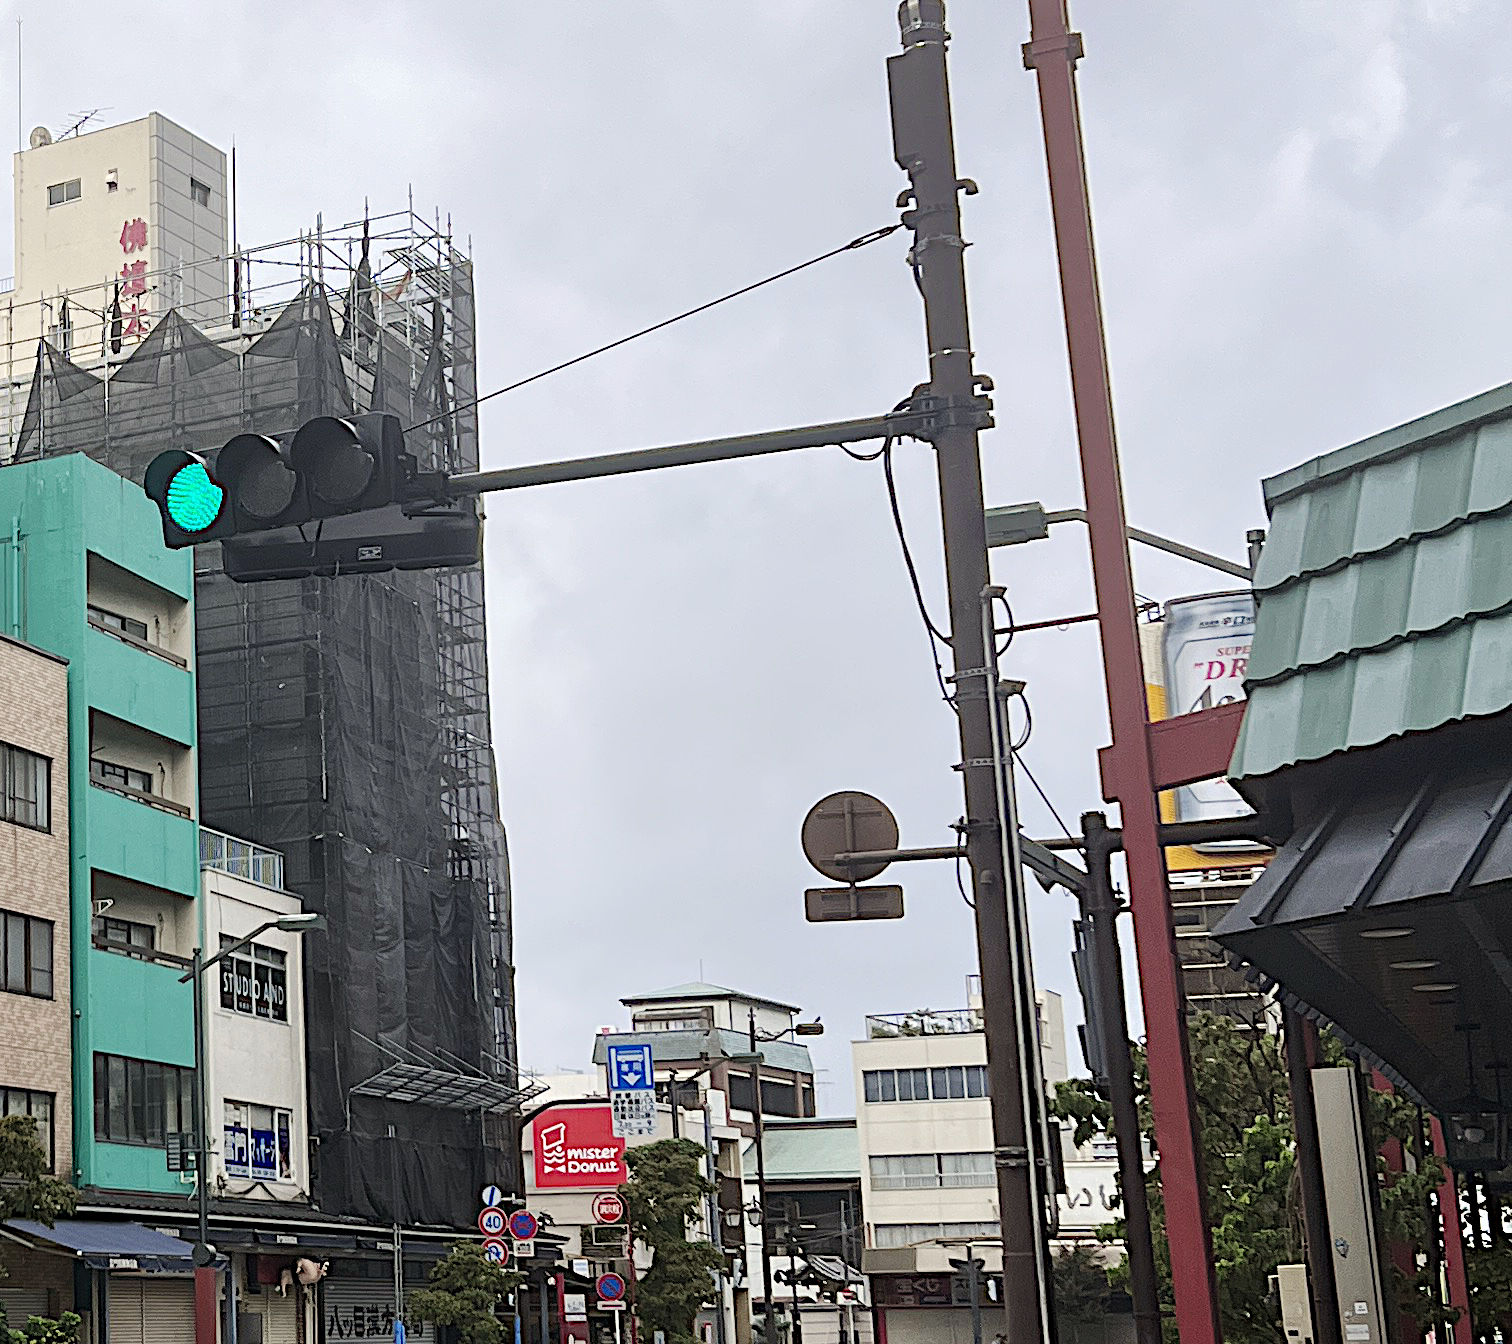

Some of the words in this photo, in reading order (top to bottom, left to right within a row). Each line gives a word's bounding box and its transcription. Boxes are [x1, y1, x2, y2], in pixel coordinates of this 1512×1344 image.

[567, 1147, 619, 1160] mister
[567, 1161, 619, 1173] Donut
[486, 1215, 501, 1229] 40
